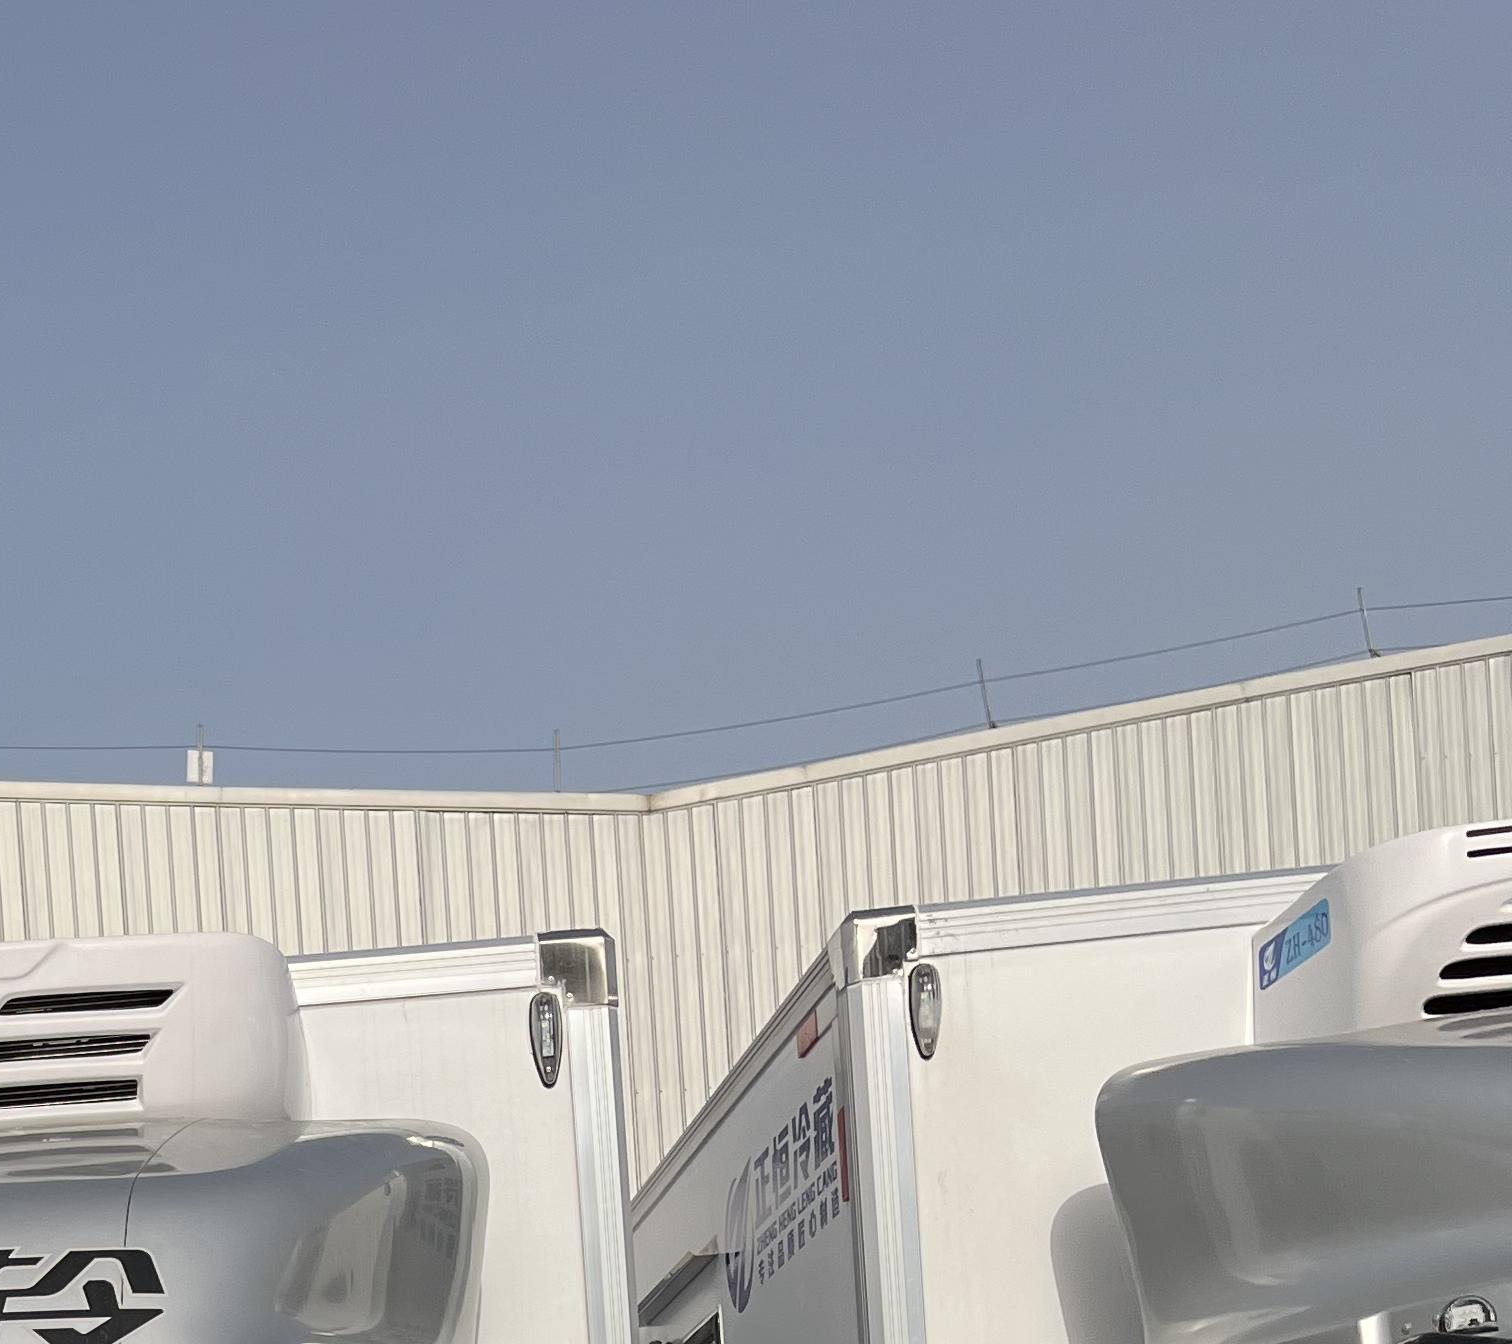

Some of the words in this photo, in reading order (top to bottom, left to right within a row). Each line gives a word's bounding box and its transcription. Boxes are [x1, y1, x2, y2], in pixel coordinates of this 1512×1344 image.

[754, 1077, 834, 1229] 正恒冷藏
[778, 1200, 797, 1233] HENG
[798, 1179, 816, 1215] LENG
[817, 1160, 838, 1197] CANG
